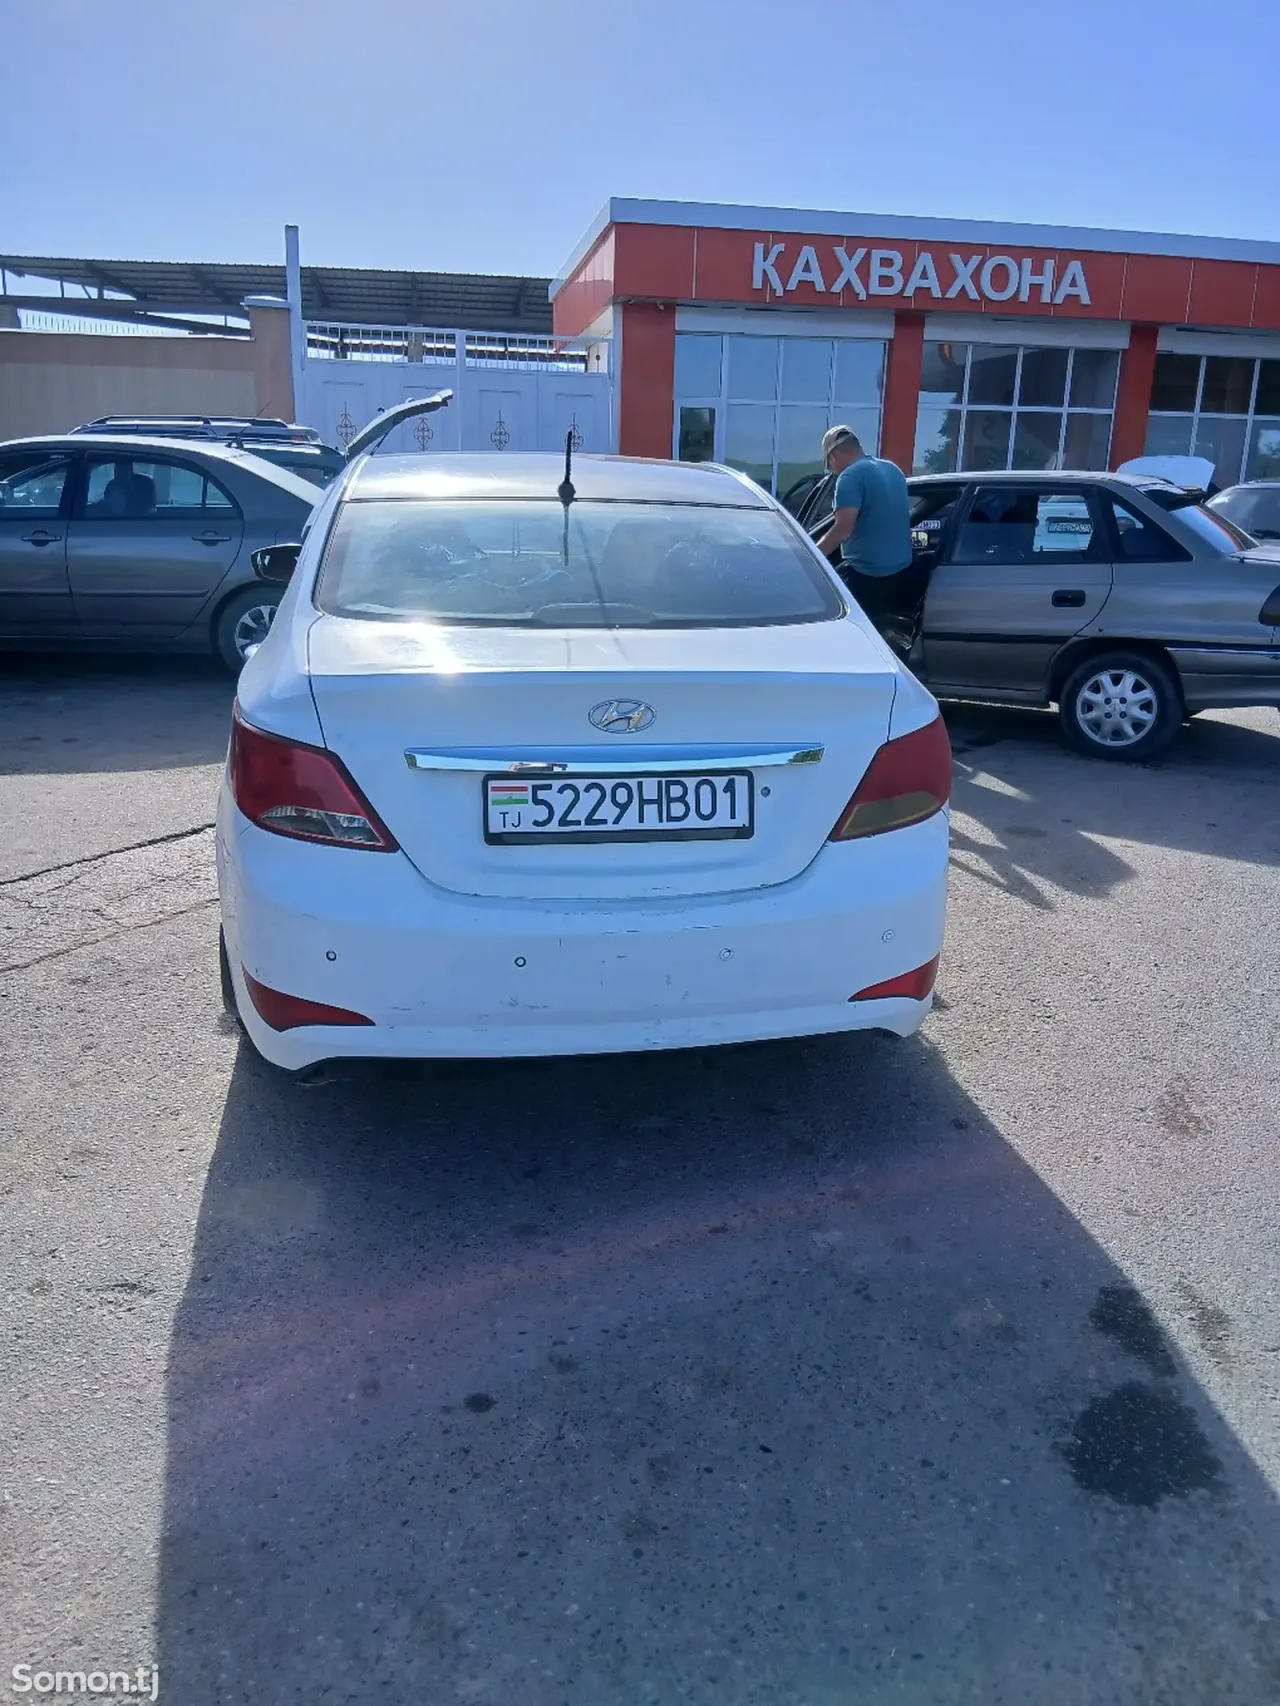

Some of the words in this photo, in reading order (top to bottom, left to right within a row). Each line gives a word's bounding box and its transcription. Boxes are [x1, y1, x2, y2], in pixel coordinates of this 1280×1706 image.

[752, 242, 1091, 305] ҚАҲВАХОНА
[499, 811, 521, 829] TJ
[531, 777, 736, 828] 5229HB01
